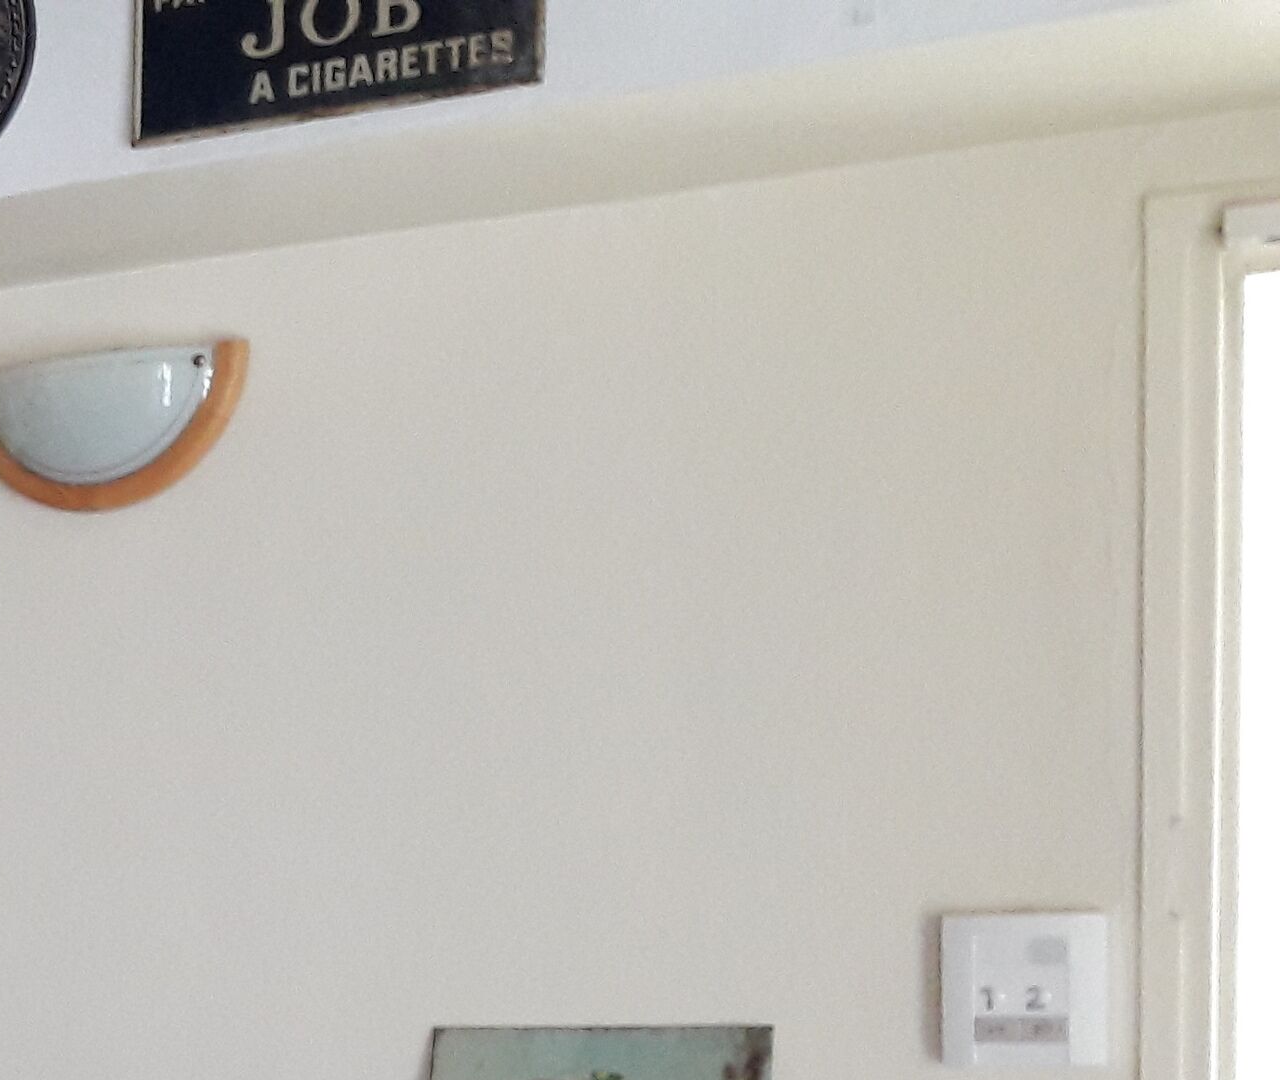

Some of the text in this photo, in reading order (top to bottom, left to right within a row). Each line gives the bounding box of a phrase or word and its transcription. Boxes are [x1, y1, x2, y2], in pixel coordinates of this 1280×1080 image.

[248, 29, 515, 105] A CIGARETTES
[980, 985, 1046, 1012] 1 2
